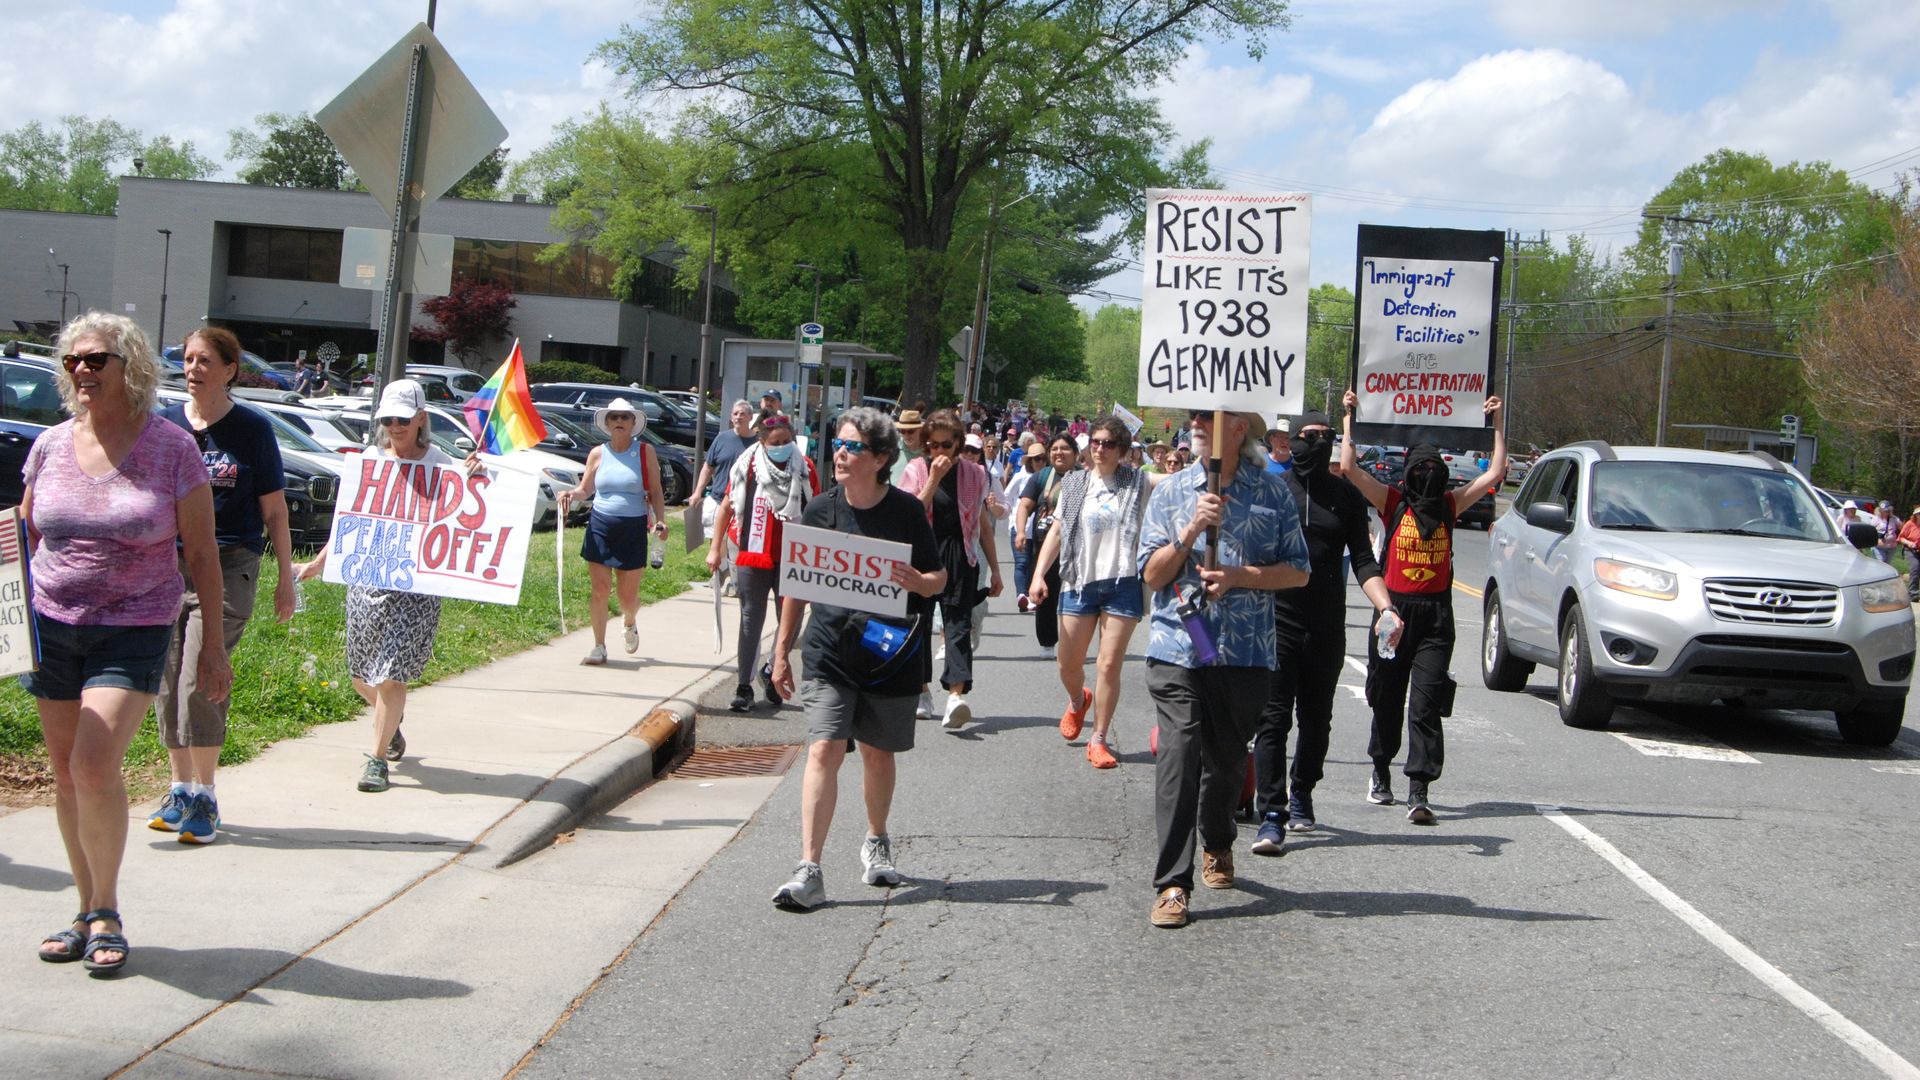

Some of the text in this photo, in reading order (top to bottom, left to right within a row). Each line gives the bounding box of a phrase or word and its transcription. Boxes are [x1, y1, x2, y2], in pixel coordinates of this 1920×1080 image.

[1157, 201, 1297, 255] RESIST
[1156, 259, 1288, 296] LIKE IT'S
[1179, 299, 1271, 338] 1938
[1383, 298, 1457, 318] Detention
[1148, 339, 1296, 397] GERMANY
[1404, 352, 1438, 369] are
[1365, 372, 1486, 393] CONCENTRATION
[1392, 393, 1453, 417] CAMPS
[351, 459, 491, 530] HANDS
[334, 515, 414, 559] PEACE
[752, 497, 768, 540] EGYPT
[423, 523, 514, 580] OFF!
[786, 540, 906, 582] RESIST
[1396, 548, 1406, 562] TO
[1407, 550, 1431, 565] WORK
[341, 553, 416, 590] CORPS
[786, 567, 902, 600] AUTOCRACY
